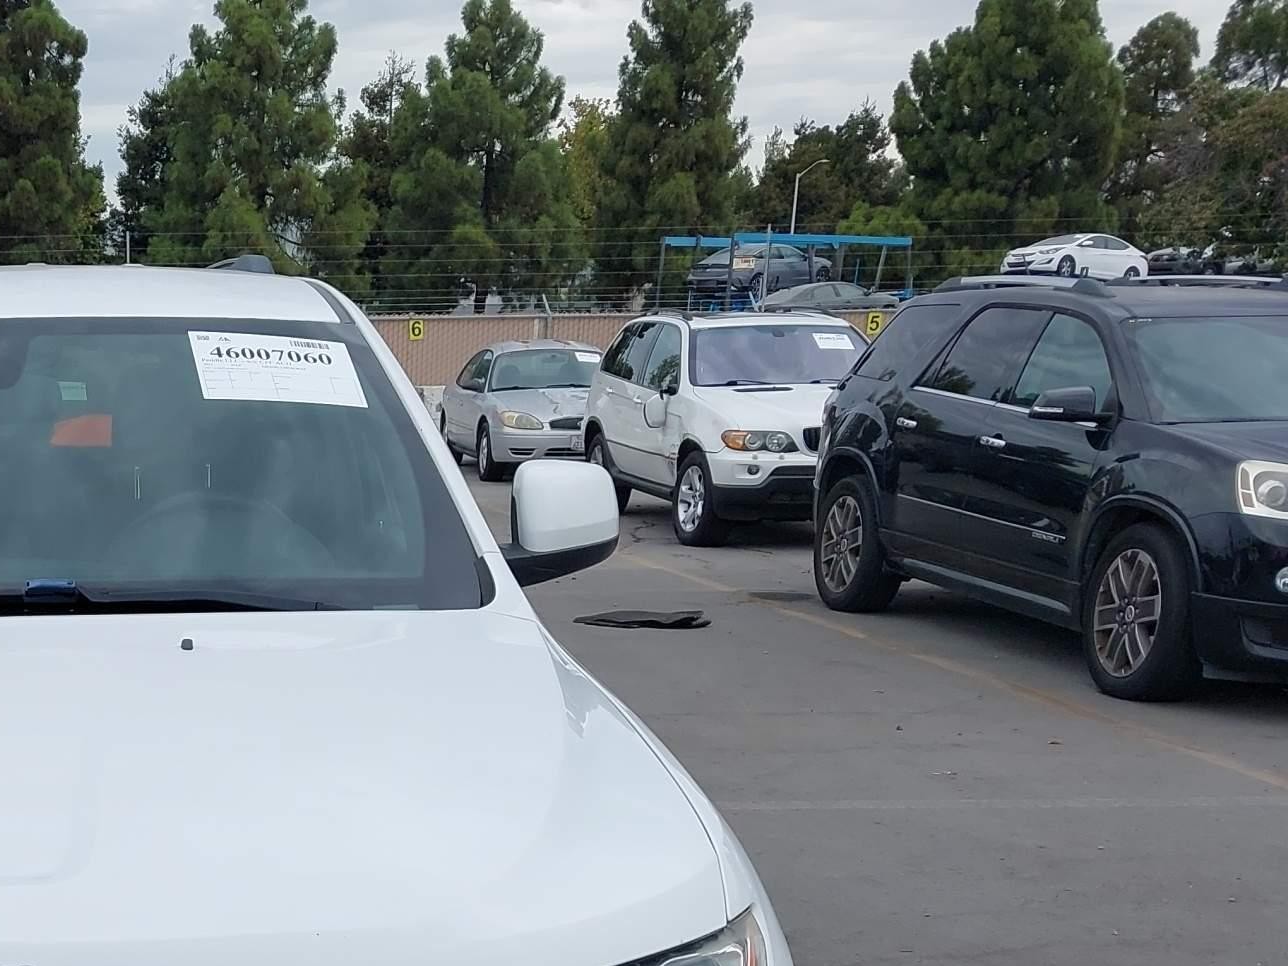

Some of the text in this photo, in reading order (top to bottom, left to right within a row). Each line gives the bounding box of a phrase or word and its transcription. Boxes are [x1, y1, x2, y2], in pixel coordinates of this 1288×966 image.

[412, 321, 421, 336] 6
[869, 315, 881, 331] 5
[210, 346, 333, 366] 46007060
